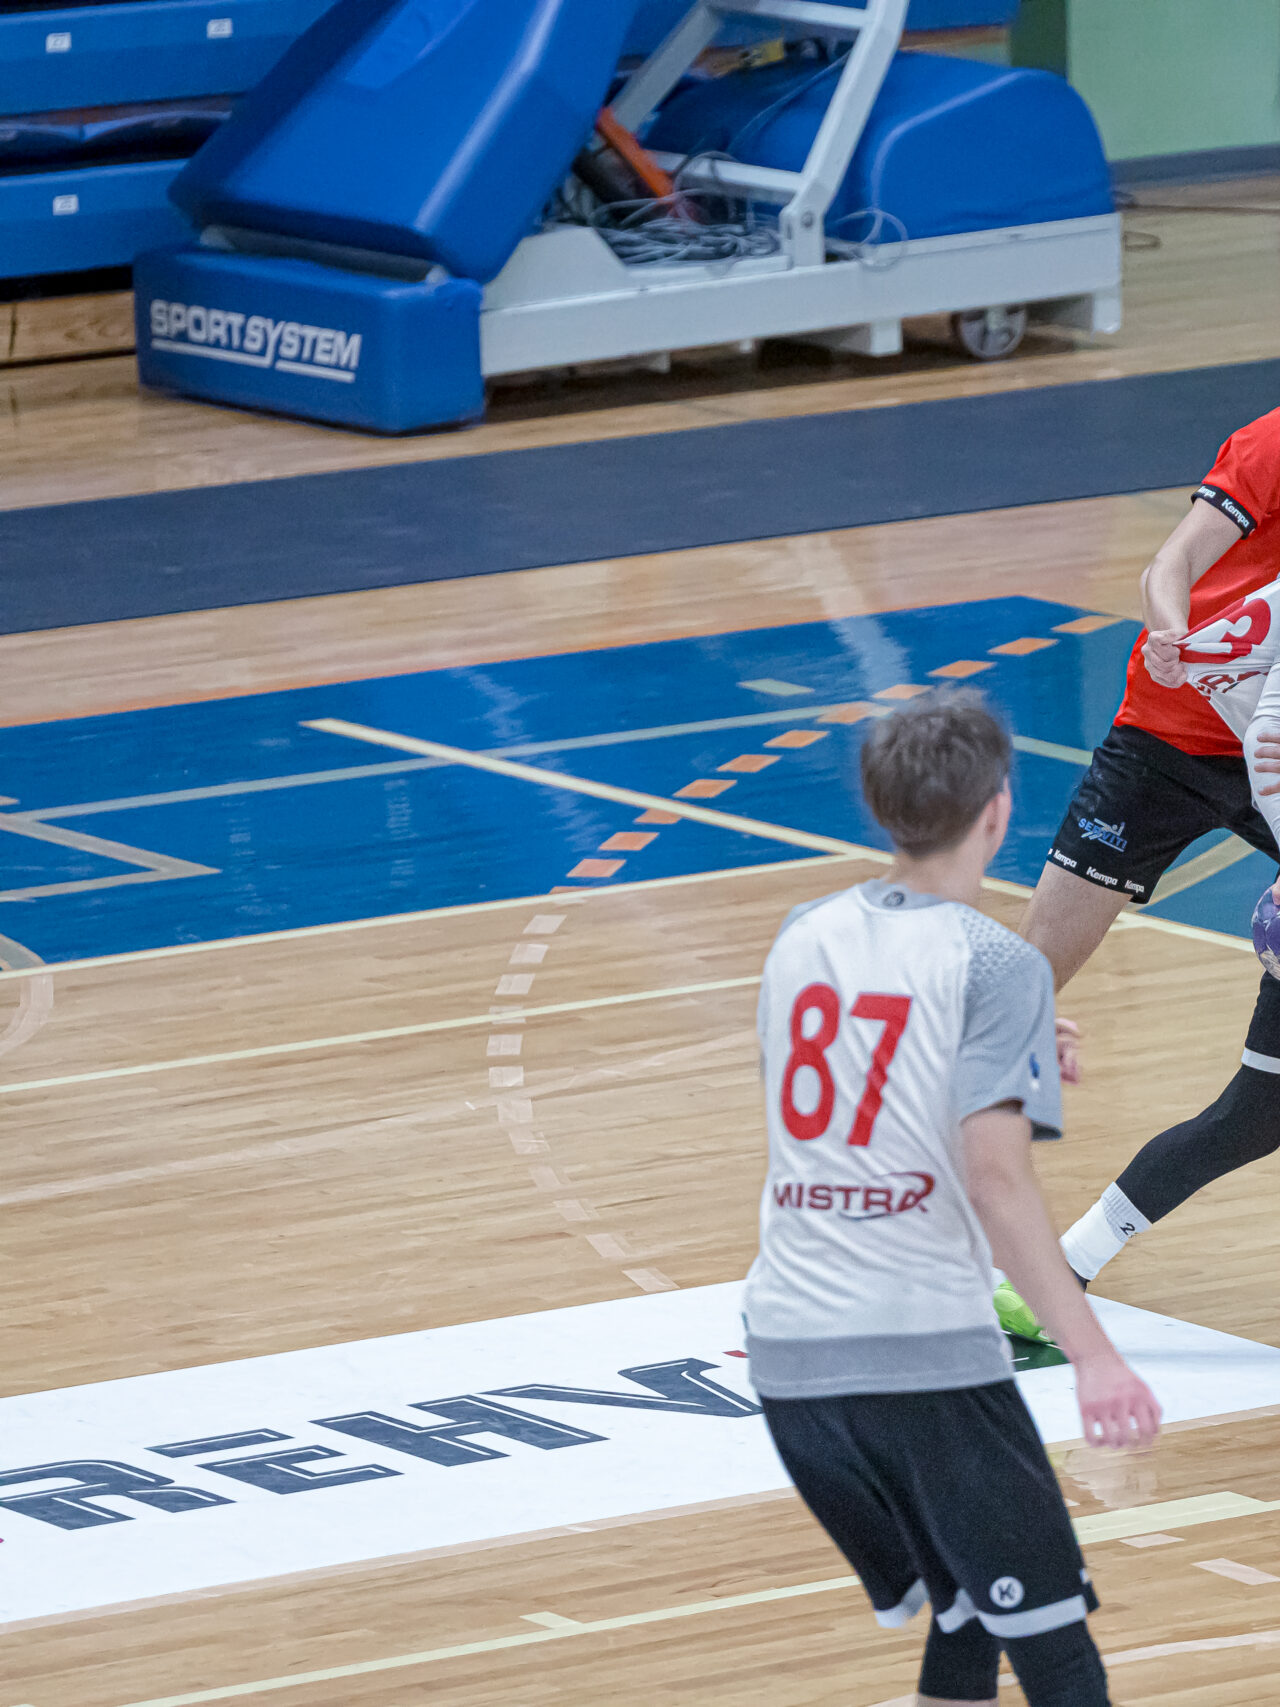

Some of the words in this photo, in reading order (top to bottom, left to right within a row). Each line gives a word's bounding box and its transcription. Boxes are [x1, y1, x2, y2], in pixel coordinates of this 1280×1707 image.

[1221, 498, 1250, 528] Kempa
[1053, 849, 1078, 869] Kempa
[1086, 866, 1119, 886] Kempa
[781, 982, 912, 1147] 87
